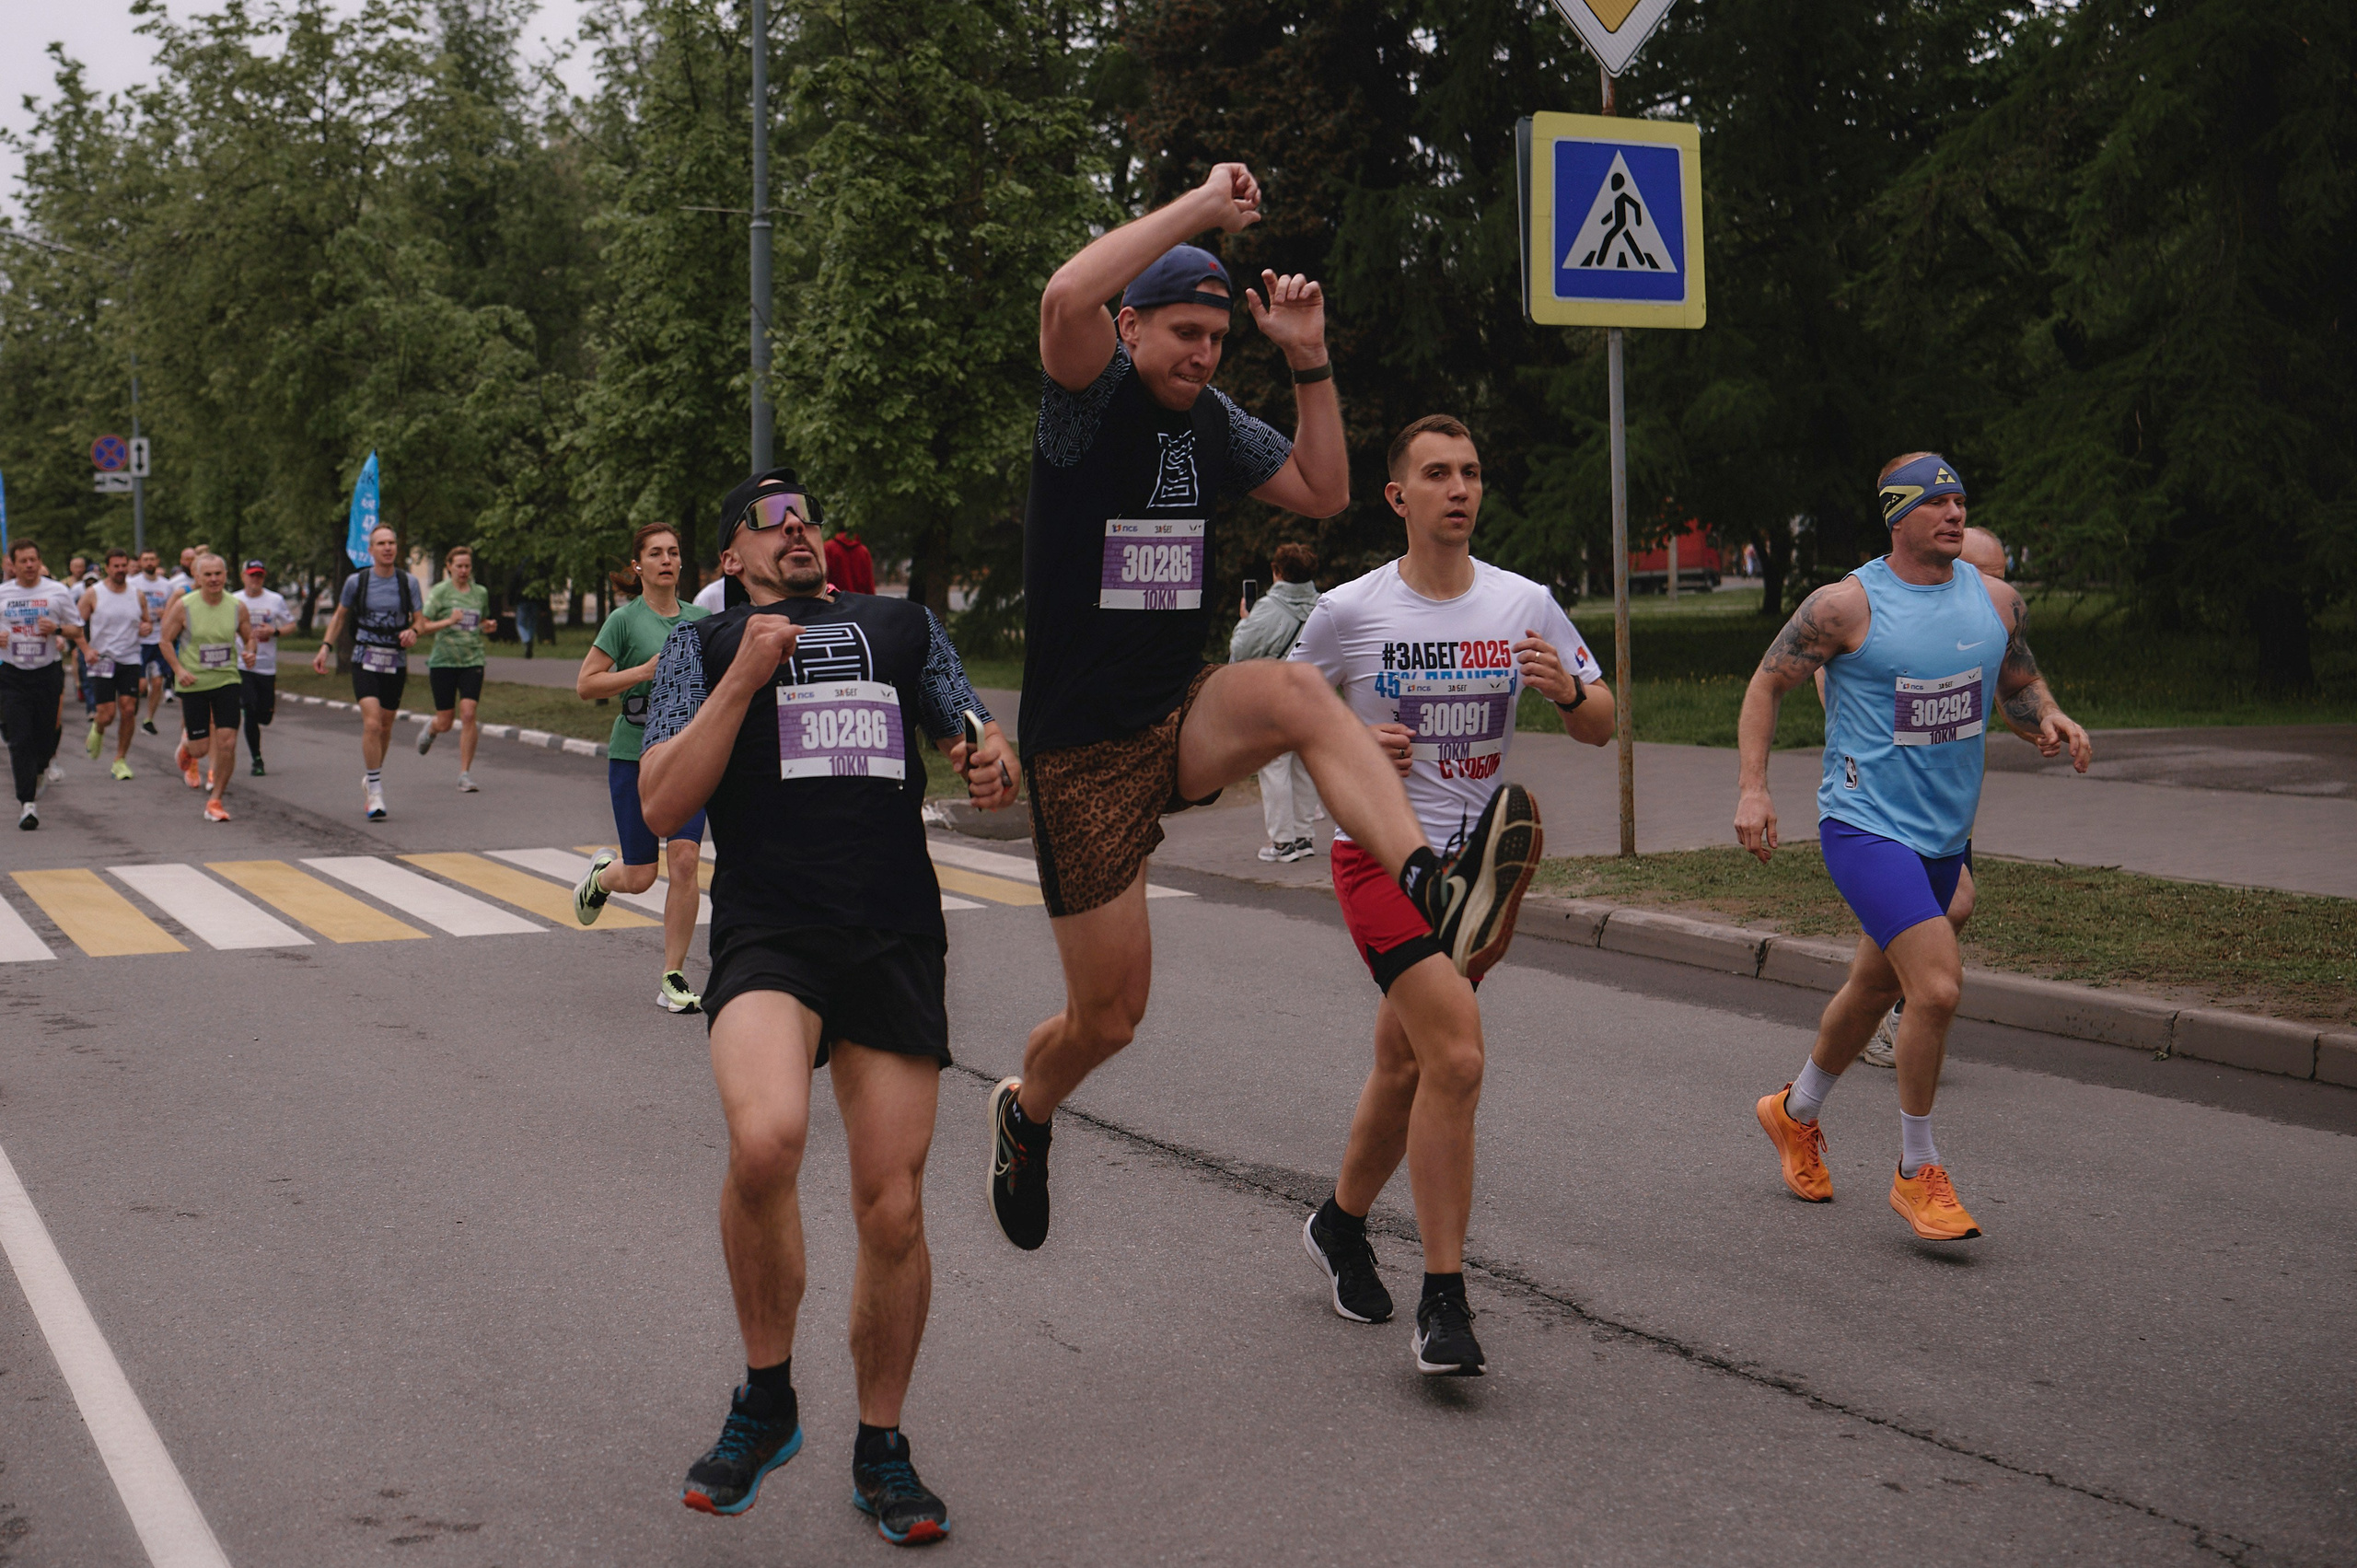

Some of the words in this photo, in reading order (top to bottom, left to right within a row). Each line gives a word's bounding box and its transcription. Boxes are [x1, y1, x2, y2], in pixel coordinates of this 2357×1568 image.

[1120, 544, 1192, 583] 30285
[797, 691, 815, 700] ПСБ
[1910, 691, 1972, 727] 30292
[800, 708, 888, 750] 30286
[1419, 702, 1491, 737] 30091
